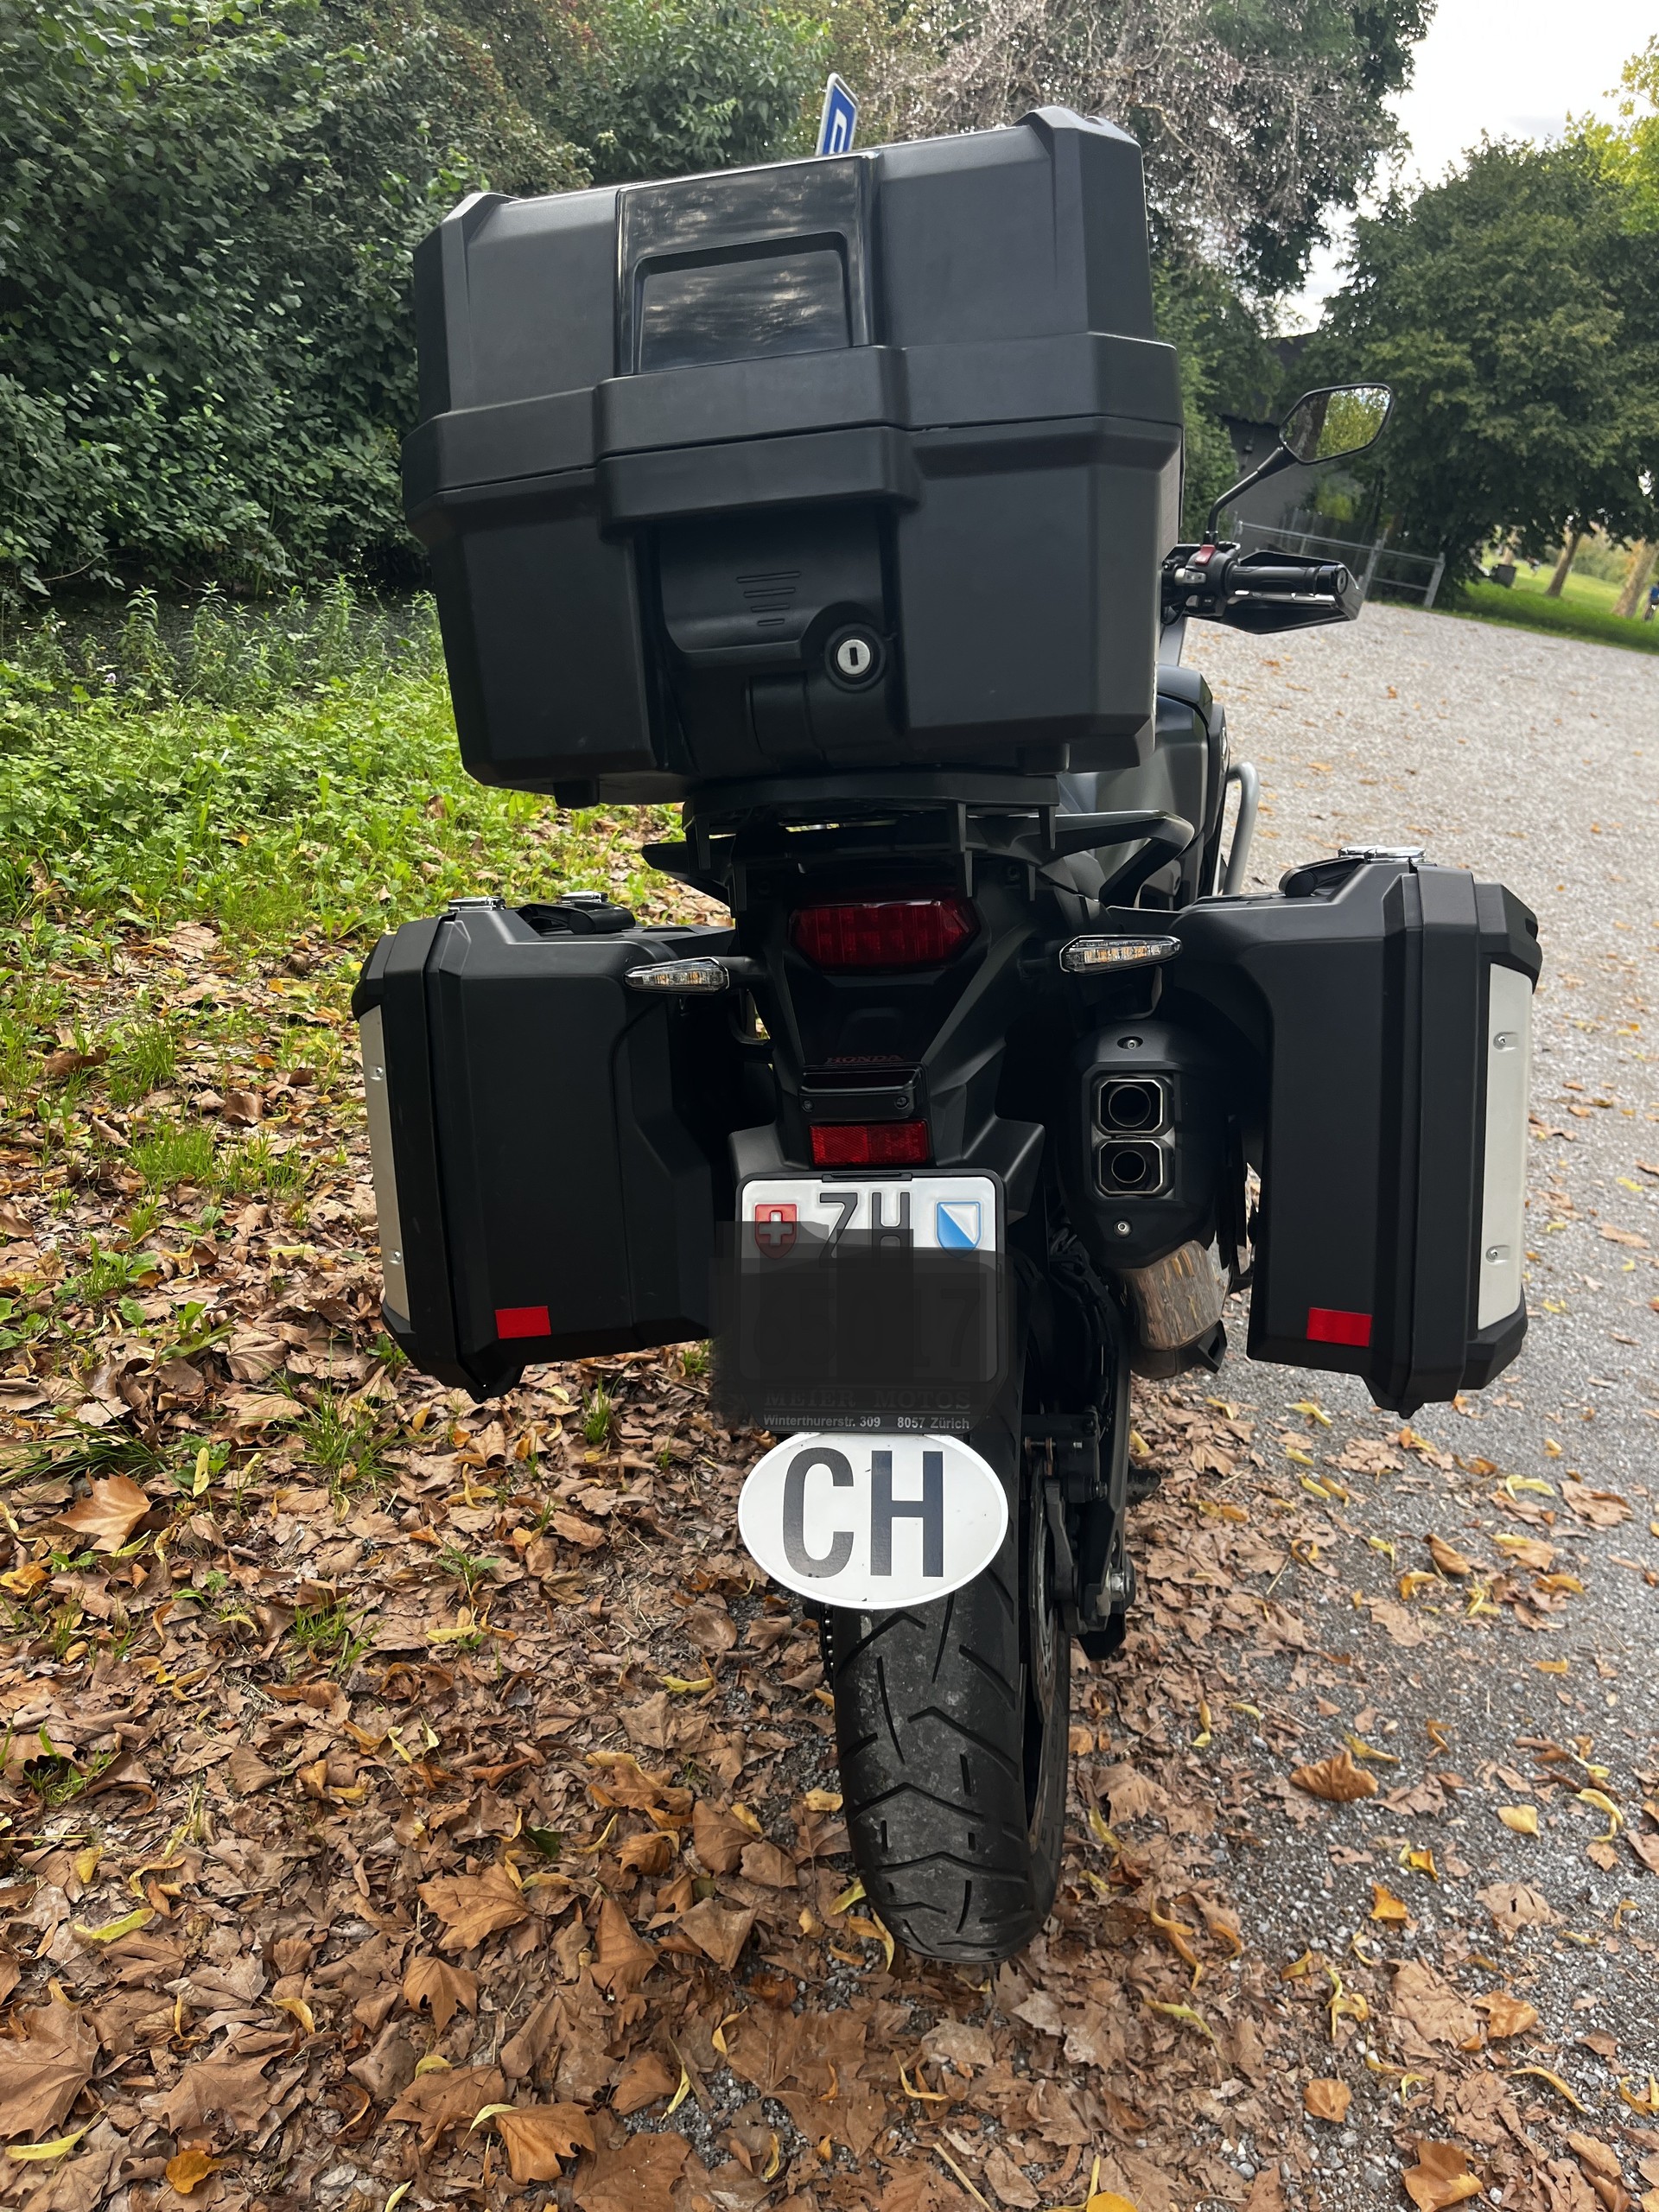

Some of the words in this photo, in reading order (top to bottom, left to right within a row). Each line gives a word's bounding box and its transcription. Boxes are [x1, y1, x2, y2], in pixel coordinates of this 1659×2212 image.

[824, 1055, 904, 1065] HONDA
[819, 1192, 911, 1265] ZH
[763, 1414, 856, 1427] Winterthurerstr.
[859, 1415, 881, 1427] 309
[897, 1416, 926, 1428] 8057
[930, 1417, 969, 1429] Zürich
[783, 1447, 944, 1579] CH
